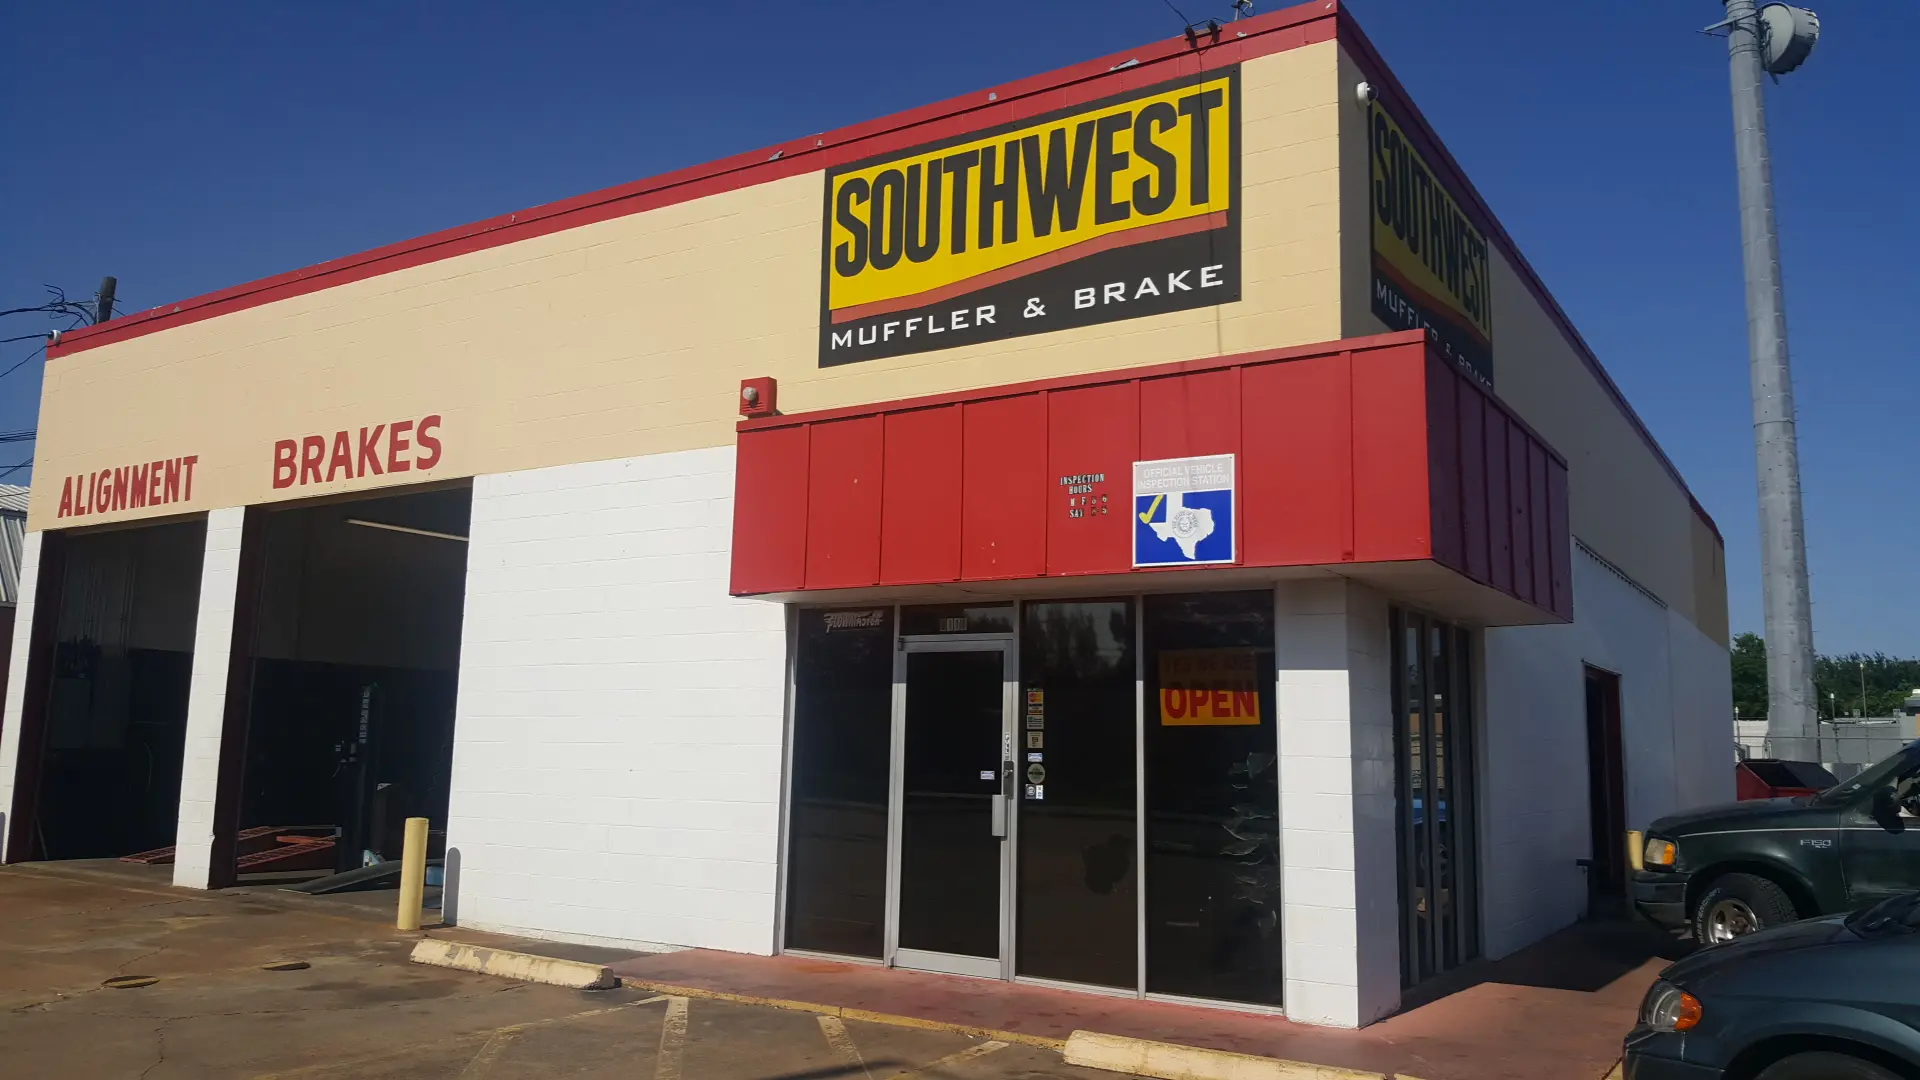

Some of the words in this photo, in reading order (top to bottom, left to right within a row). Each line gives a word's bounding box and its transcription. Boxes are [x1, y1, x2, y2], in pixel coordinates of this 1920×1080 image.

[835, 89, 1223, 278] SOUTHWEST
[1375, 111, 1488, 334] SOUTHWEST
[831, 304, 997, 350] MUFFLER
[1023, 297, 1046, 319] &
[1074, 263, 1225, 310] BRAKE
[272, 414, 443, 490] BRAKES
[1143, 466, 1183, 479] OFFICIAL
[1184, 463, 1223, 476] VEHICLE
[58, 455, 198, 519] ALIGNMENT
[1060, 473, 1105, 486] INSPECTION
[1068, 484, 1093, 495] HOURS
[1137, 476, 1190, 490] INSPECTION
[1191, 473, 1230, 486] STATION
[1164, 680, 1256, 719] OPEN
